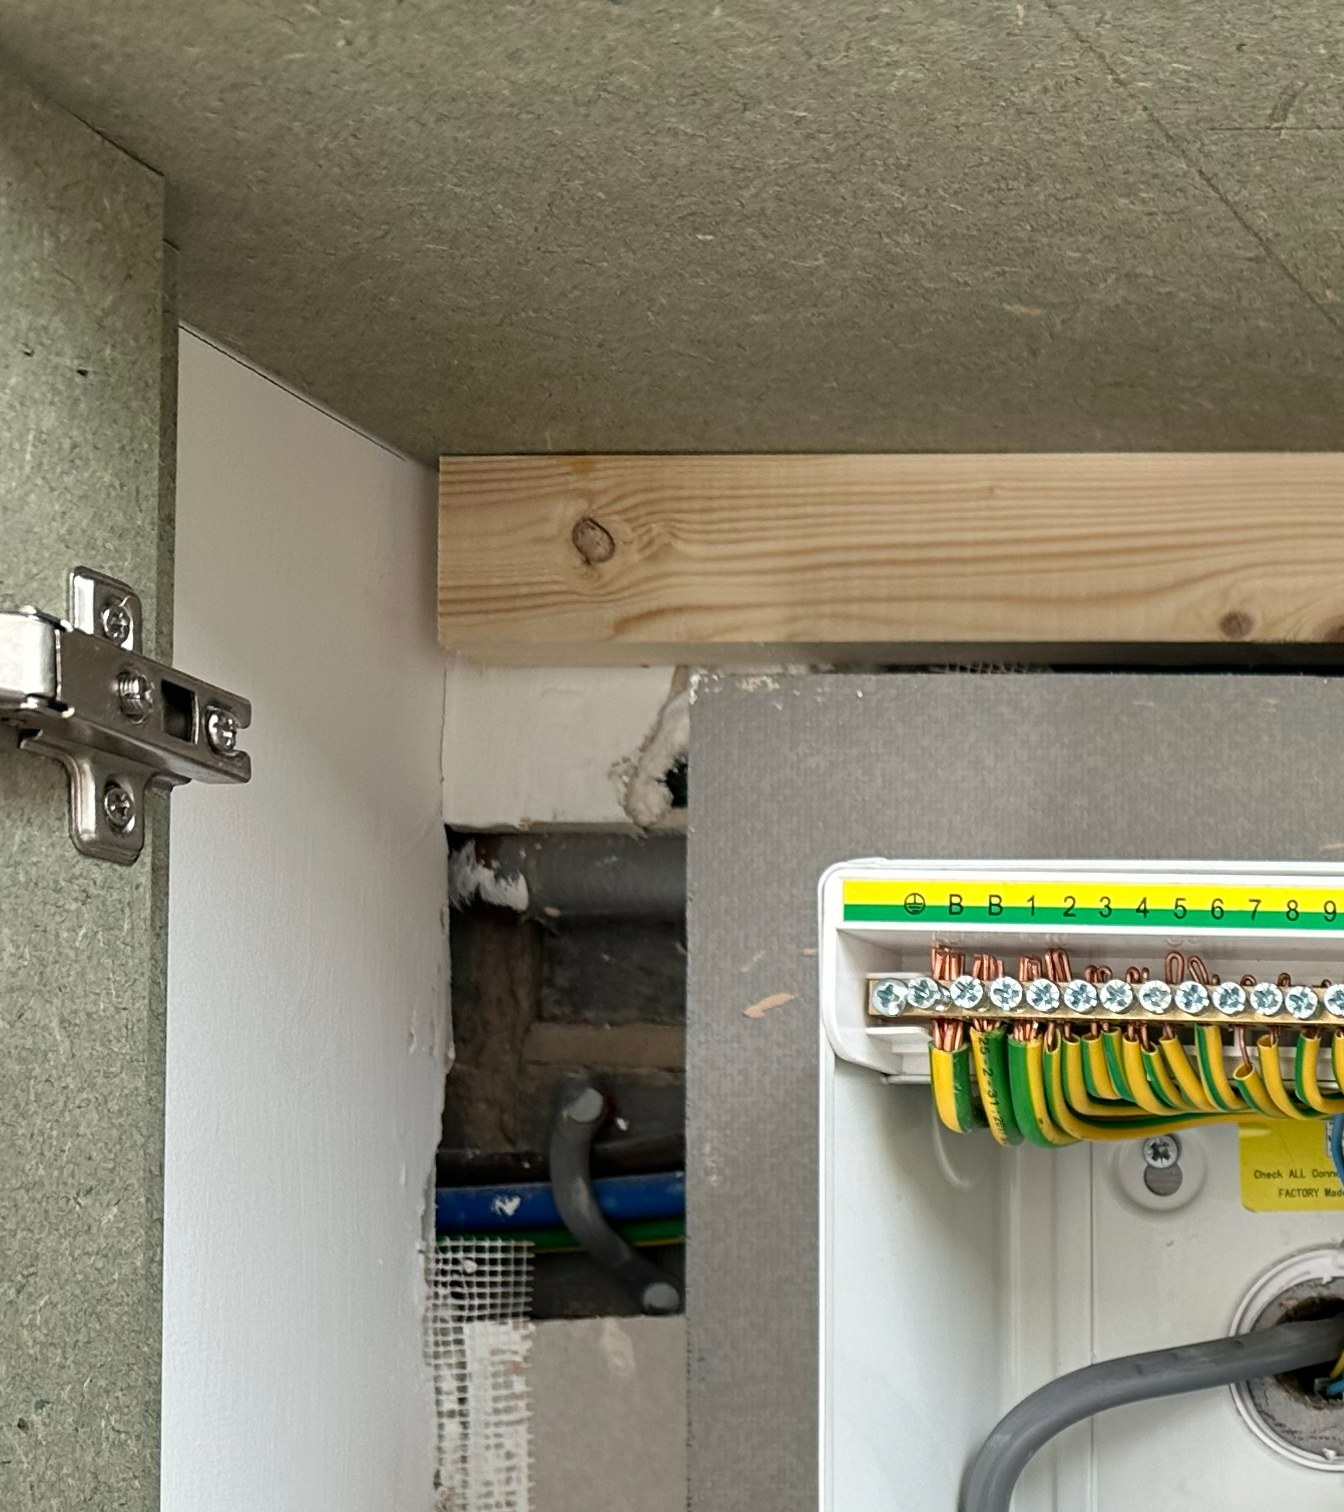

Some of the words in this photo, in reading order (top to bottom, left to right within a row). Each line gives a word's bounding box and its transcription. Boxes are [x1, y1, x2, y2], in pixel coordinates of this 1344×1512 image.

[948, 894, 964, 916] B
[988, 894, 1004, 916] B
[1027, 895, 1036, 917] 1
[1063, 896, 1077, 918] 2
[1099, 897, 1112, 918] 3
[1135, 898, 1149, 919] 4
[1173, 898, 1187, 920] 5
[1210, 898, 1225, 920] 6
[1248, 899, 1262, 921] 7
[1286, 900, 1299, 922] 8
[1324, 900, 1338, 922] 9
[1254, 1169, 1283, 1179] Check
[1289, 1170, 1306, 1179] ALL
[1278, 1188, 1319, 1198] FACTORY
